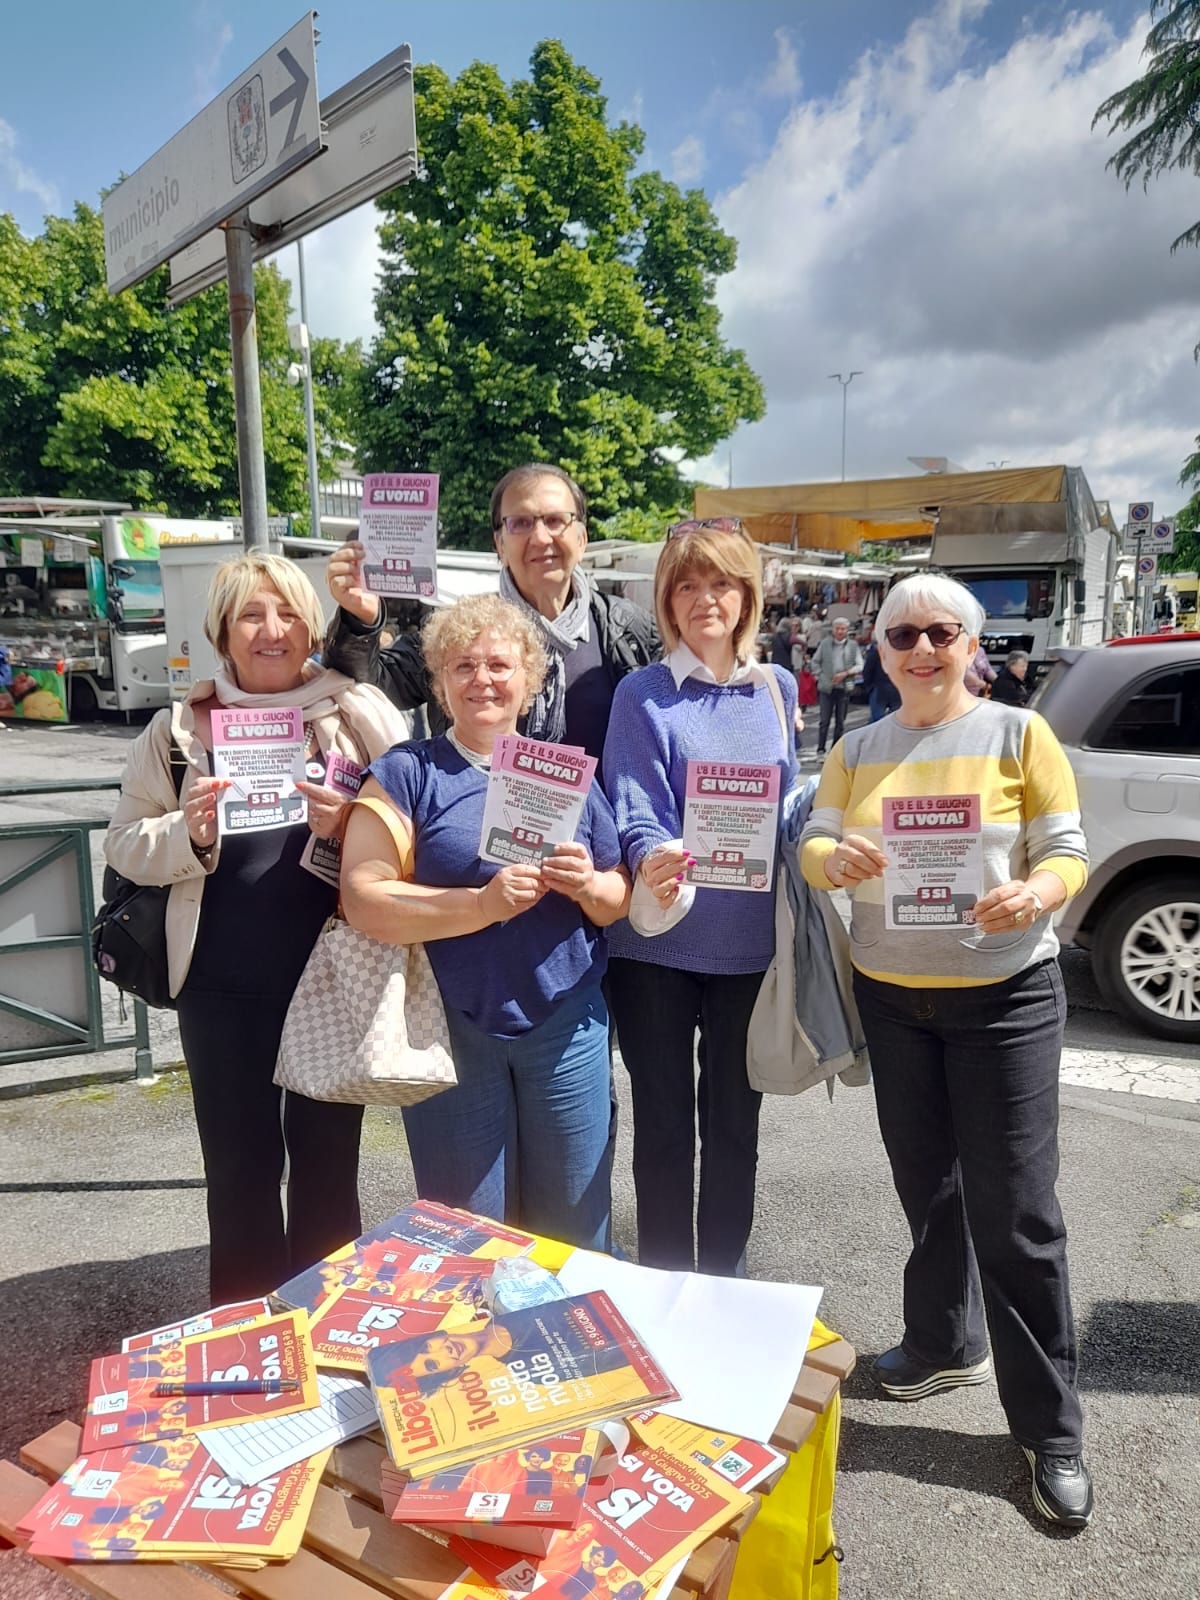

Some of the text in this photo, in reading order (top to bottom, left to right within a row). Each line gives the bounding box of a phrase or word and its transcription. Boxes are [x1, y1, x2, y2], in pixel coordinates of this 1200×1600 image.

[109, 176, 180, 256] municipio
[380, 479, 384, 487] E
[402, 479, 431, 488] GIUGNO
[373, 490, 424, 503] SI VOTA!
[369, 581, 417, 592] REFERENDUM
[221, 714, 232, 722] L'8
[262, 712, 294, 721] GIUGNO
[228, 724, 288, 737] SI VOTA!
[516, 741, 588, 768] L'8 E IL 9 GIUGNO
[517, 755, 578, 782] SI VOTA!
[697, 766, 708, 774] L'8
[720, 767, 727, 776] IL
[730, 768, 735, 776] 9
[738, 768, 771, 778] GIUGNO
[701, 778, 764, 793] SI VOTA!
[252, 793, 275, 804] 5 SI
[892, 799, 971, 810] L'8 E IL 9 GIUGNO
[230, 806, 283, 818] delle donne al
[230, 814, 284, 827] REFERENDUM
[898, 812, 964, 826] SI VOTA!
[516, 829, 540, 844] 5 SI
[490, 846, 542, 867] REFERENDUM
[493, 838, 542, 858] delle donne al
[716, 852, 739, 862] 5 SI
[692, 872, 746, 884] REFERENDUM
[693, 865, 745, 875] delle donne al
[921, 889, 946, 899] 5 SI
[898, 904, 955, 913] delle donne al
[898, 913, 957, 922] REFERENDUM
[414, 1215, 447, 1229] GIUGNO
[357, 1306, 405, 1332] SÌ
[573, 1308, 597, 1334] GIUGNO
[316, 1343, 342, 1353] 2025
[328, 1329, 380, 1348] VOTA
[259, 1335, 284, 1402] SI VO
[283, 1346, 295, 1374] Giugno
[296, 1334, 309, 1383] Referendum
[288, 1374, 300, 1396] 25
[507, 1360, 546, 1413] nostra
[530, 1352, 571, 1406] rivolta
[459, 1372, 499, 1431] il voto
[487, 1376, 517, 1408] è la
[389, 1399, 405, 1431] SPECIALE
[655, 1446, 708, 1485] Referendum
[618, 1454, 695, 1513] SI VOTA
[656, 1456, 686, 1482] Giugno
[685, 1480, 713, 1499] 2025
[190, 1474, 247, 1510] SÌ
[276, 1475, 298, 1508] Giugno
[284, 1466, 315, 1520] Referendum
[479, 1495, 499, 1507] Sì
[236, 1477, 280, 1530] VOTA
[596, 1488, 658, 1530] SÌ
[264, 1509, 284, 1532] 2025
[515, 1568, 534, 1586] Sì
